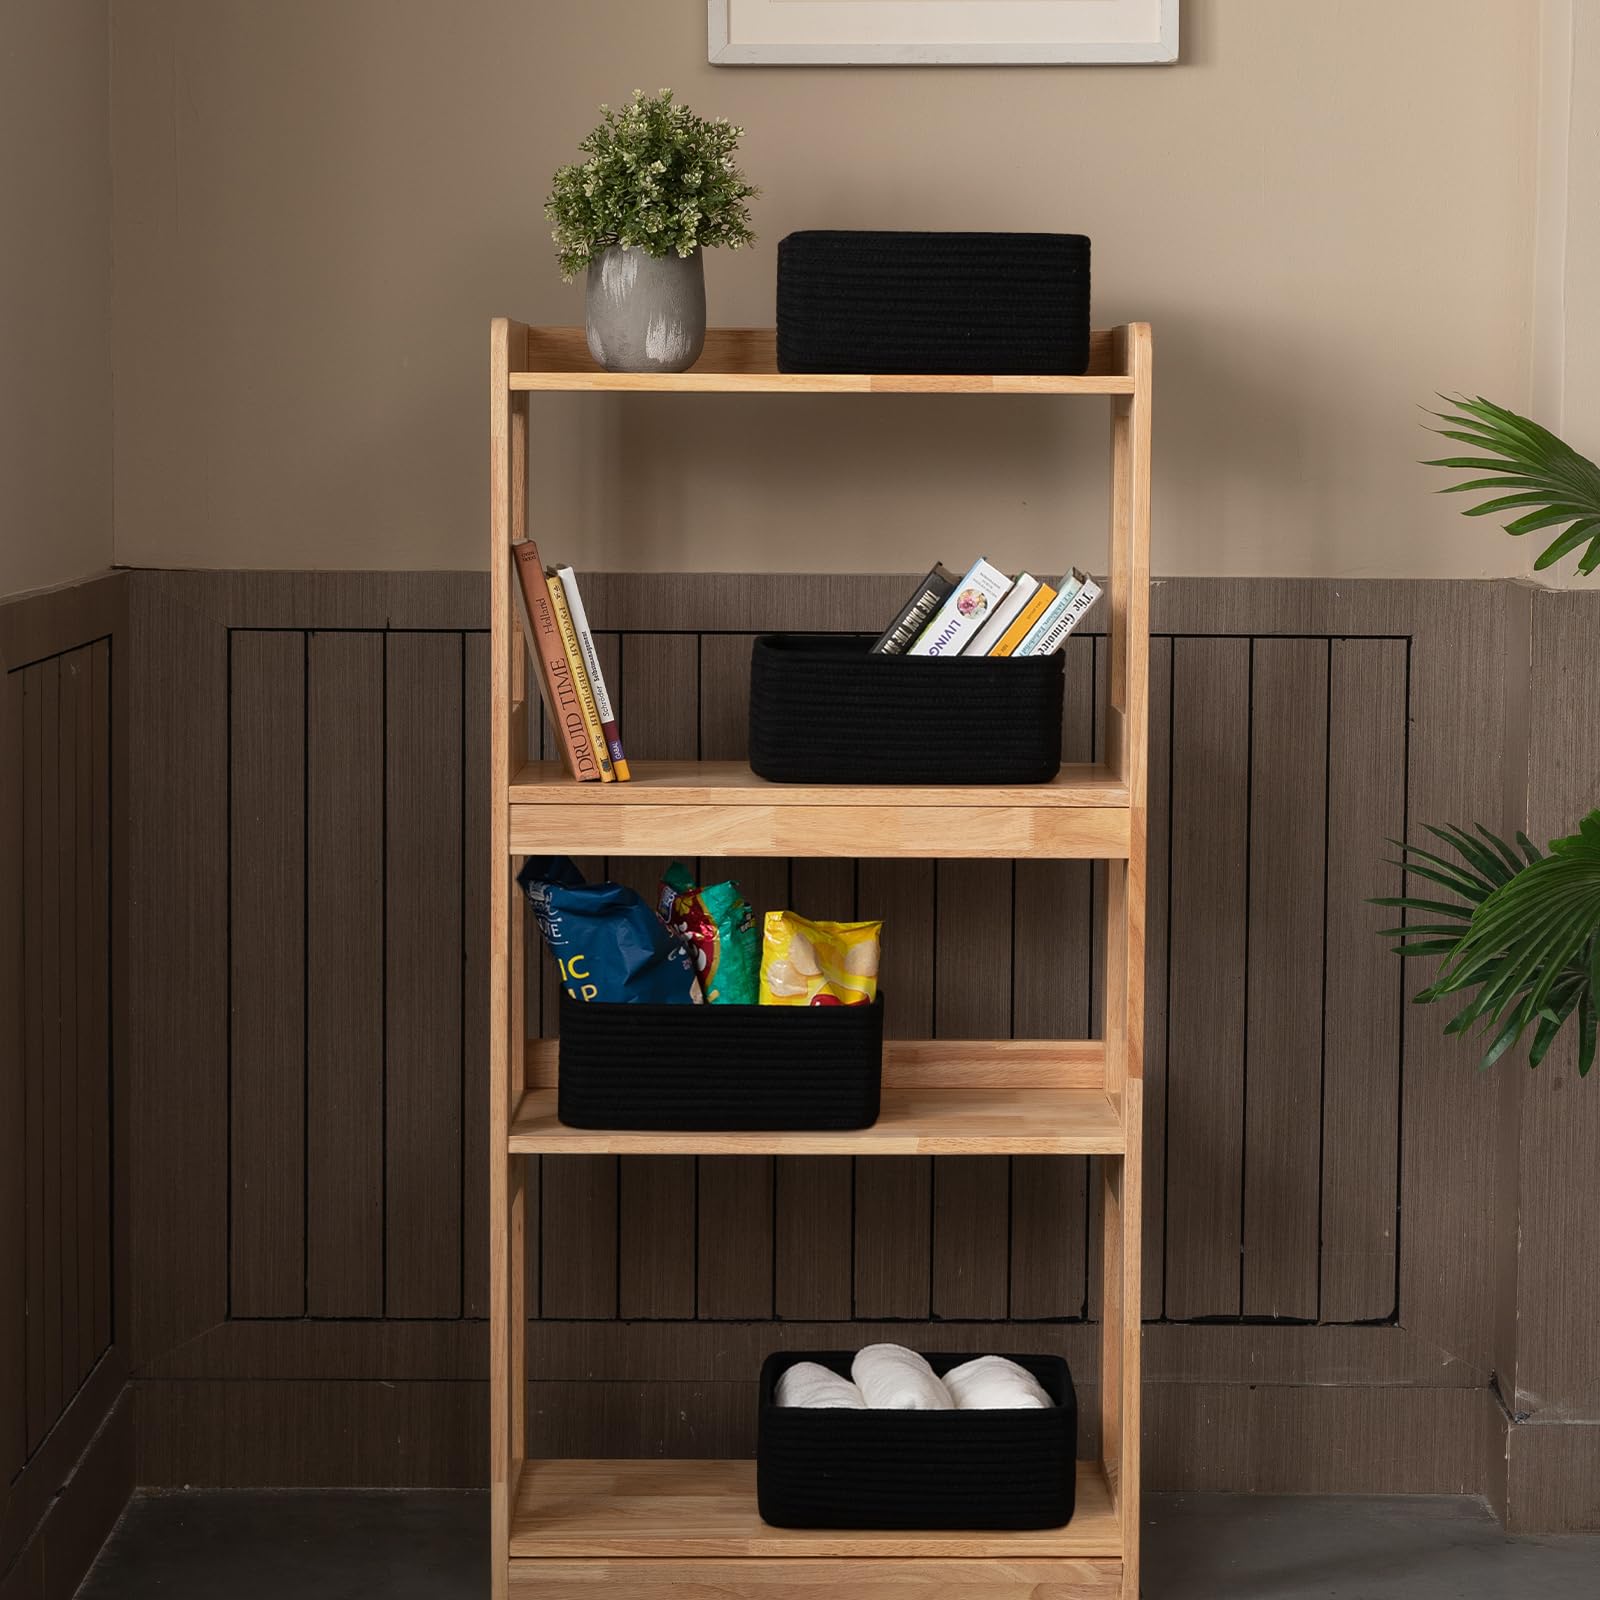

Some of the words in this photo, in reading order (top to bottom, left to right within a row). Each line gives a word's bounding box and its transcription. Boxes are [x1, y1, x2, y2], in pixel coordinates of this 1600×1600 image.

[536, 598, 553, 634] Holland
[902, 607, 926, 632] BACK
[917, 589, 941, 614] TAKE
[1073, 592, 1093, 611] The
[560, 607, 578, 656] РУССКАЯ
[891, 626, 912, 646] THE
[929, 620, 961, 656] LIVING
[550, 658, 576, 710] TIME
[566, 713, 594, 773] DRUID
